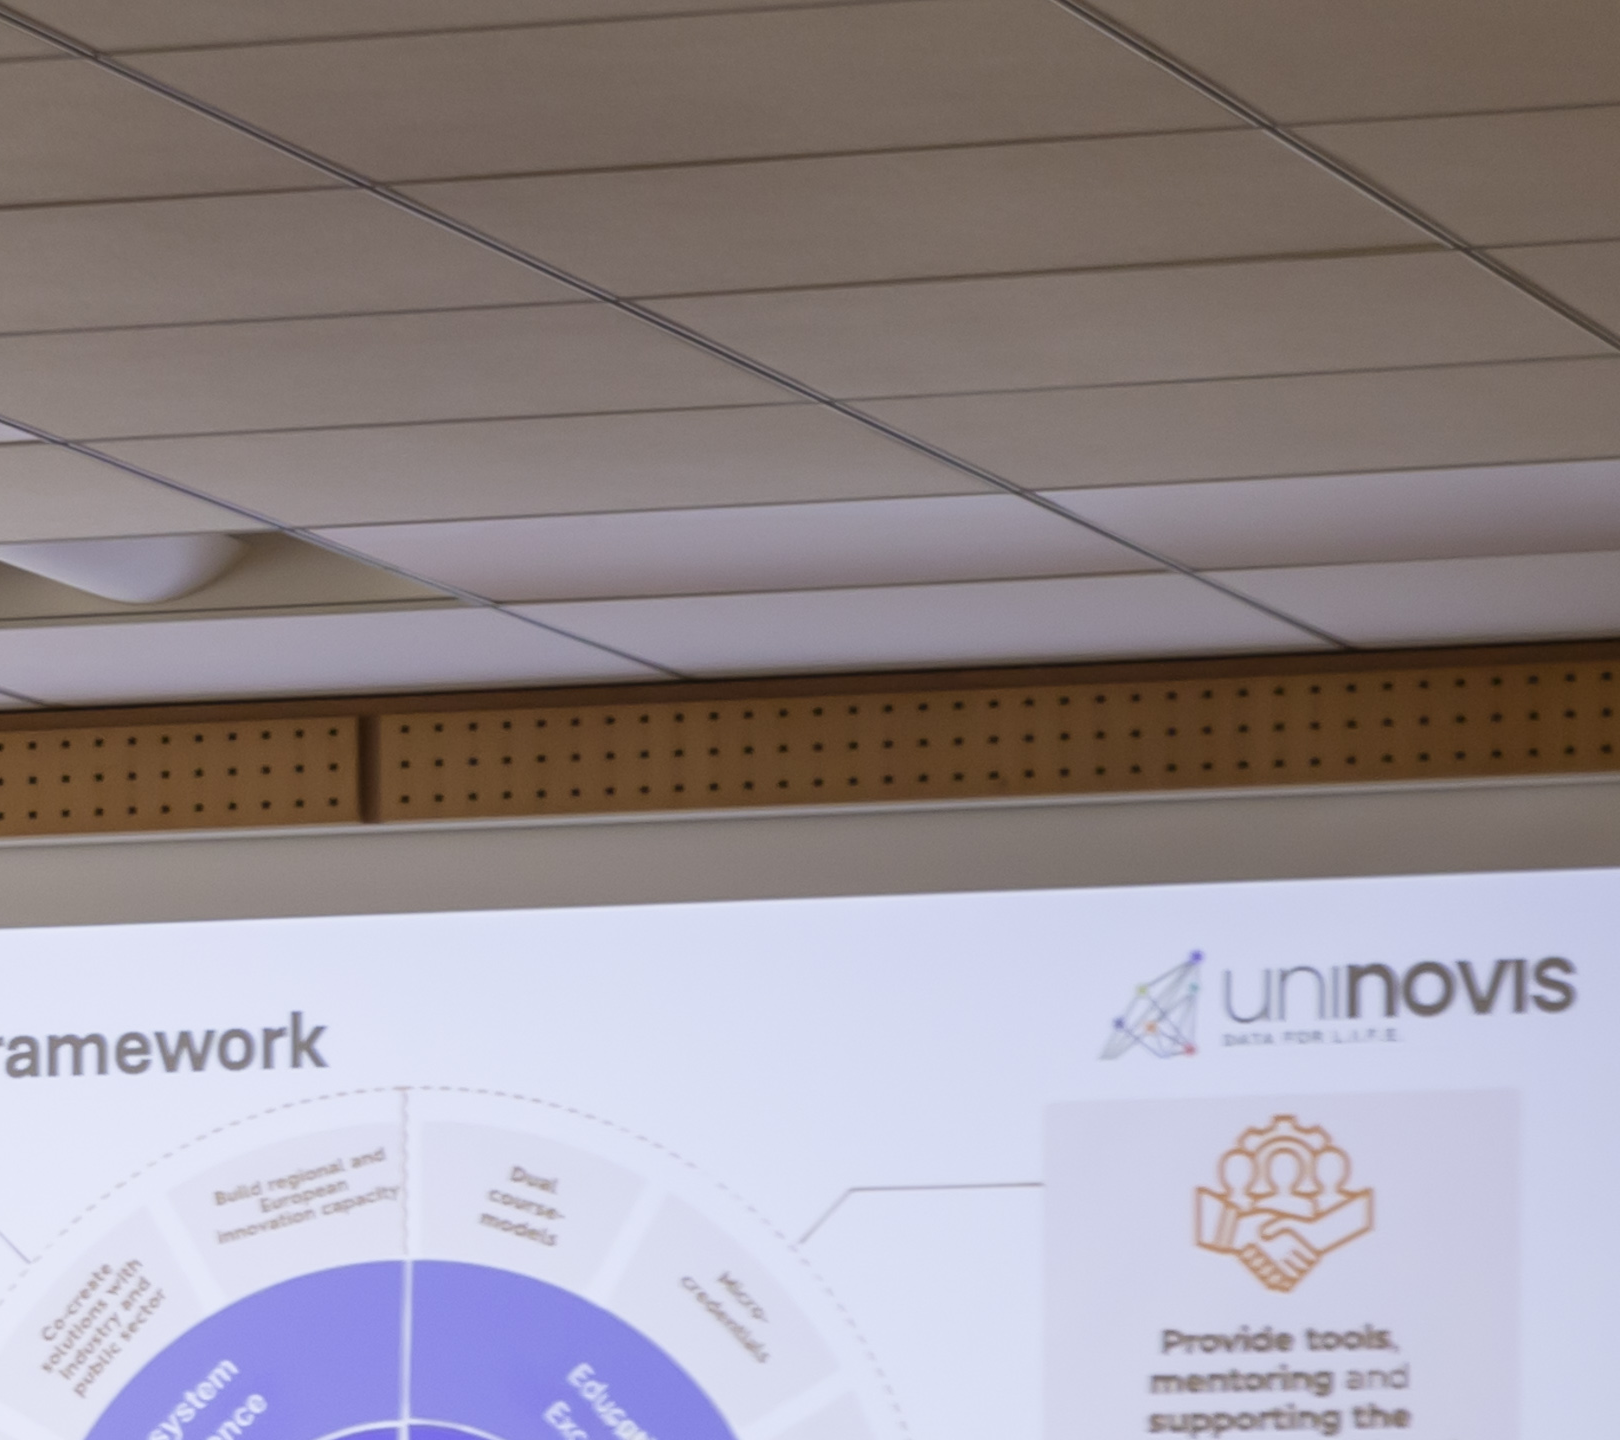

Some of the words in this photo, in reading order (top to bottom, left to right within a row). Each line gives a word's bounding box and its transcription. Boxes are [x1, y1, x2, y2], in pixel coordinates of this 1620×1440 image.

[1222, 1031, 1274, 1047] DATA
[1283, 1030, 1324, 1045] FOR
[214, 1181, 262, 1206] Build
[268, 1158, 345, 1190] regional
[351, 1147, 386, 1169] and
[260, 1180, 348, 1213] European
[511, 1166, 559, 1194] Dual
[217, 1209, 315, 1243] innovation
[321, 1186, 399, 1215] capacity
[479, 1213, 558, 1247] models
[42, 1264, 112, 1341] Co-create
[42, 1300, 108, 1373] solutions
[106, 1259, 143, 1295] with
[680, 1275, 770, 1363] credentials
[59, 1312, 122, 1380] industry
[121, 1276, 151, 1311] and
[74, 1343, 122, 1398] public
[121, 1289, 166, 1341] sector
[1162, 1325, 1294, 1354] Provide
[1306, 1324, 1399, 1352] tools,
[1149, 1364, 1334, 1396] mentoring
[1346, 1365, 1409, 1390] and
[1148, 1404, 1342, 1437] supporting
[1352, 1404, 1410, 1429] the
